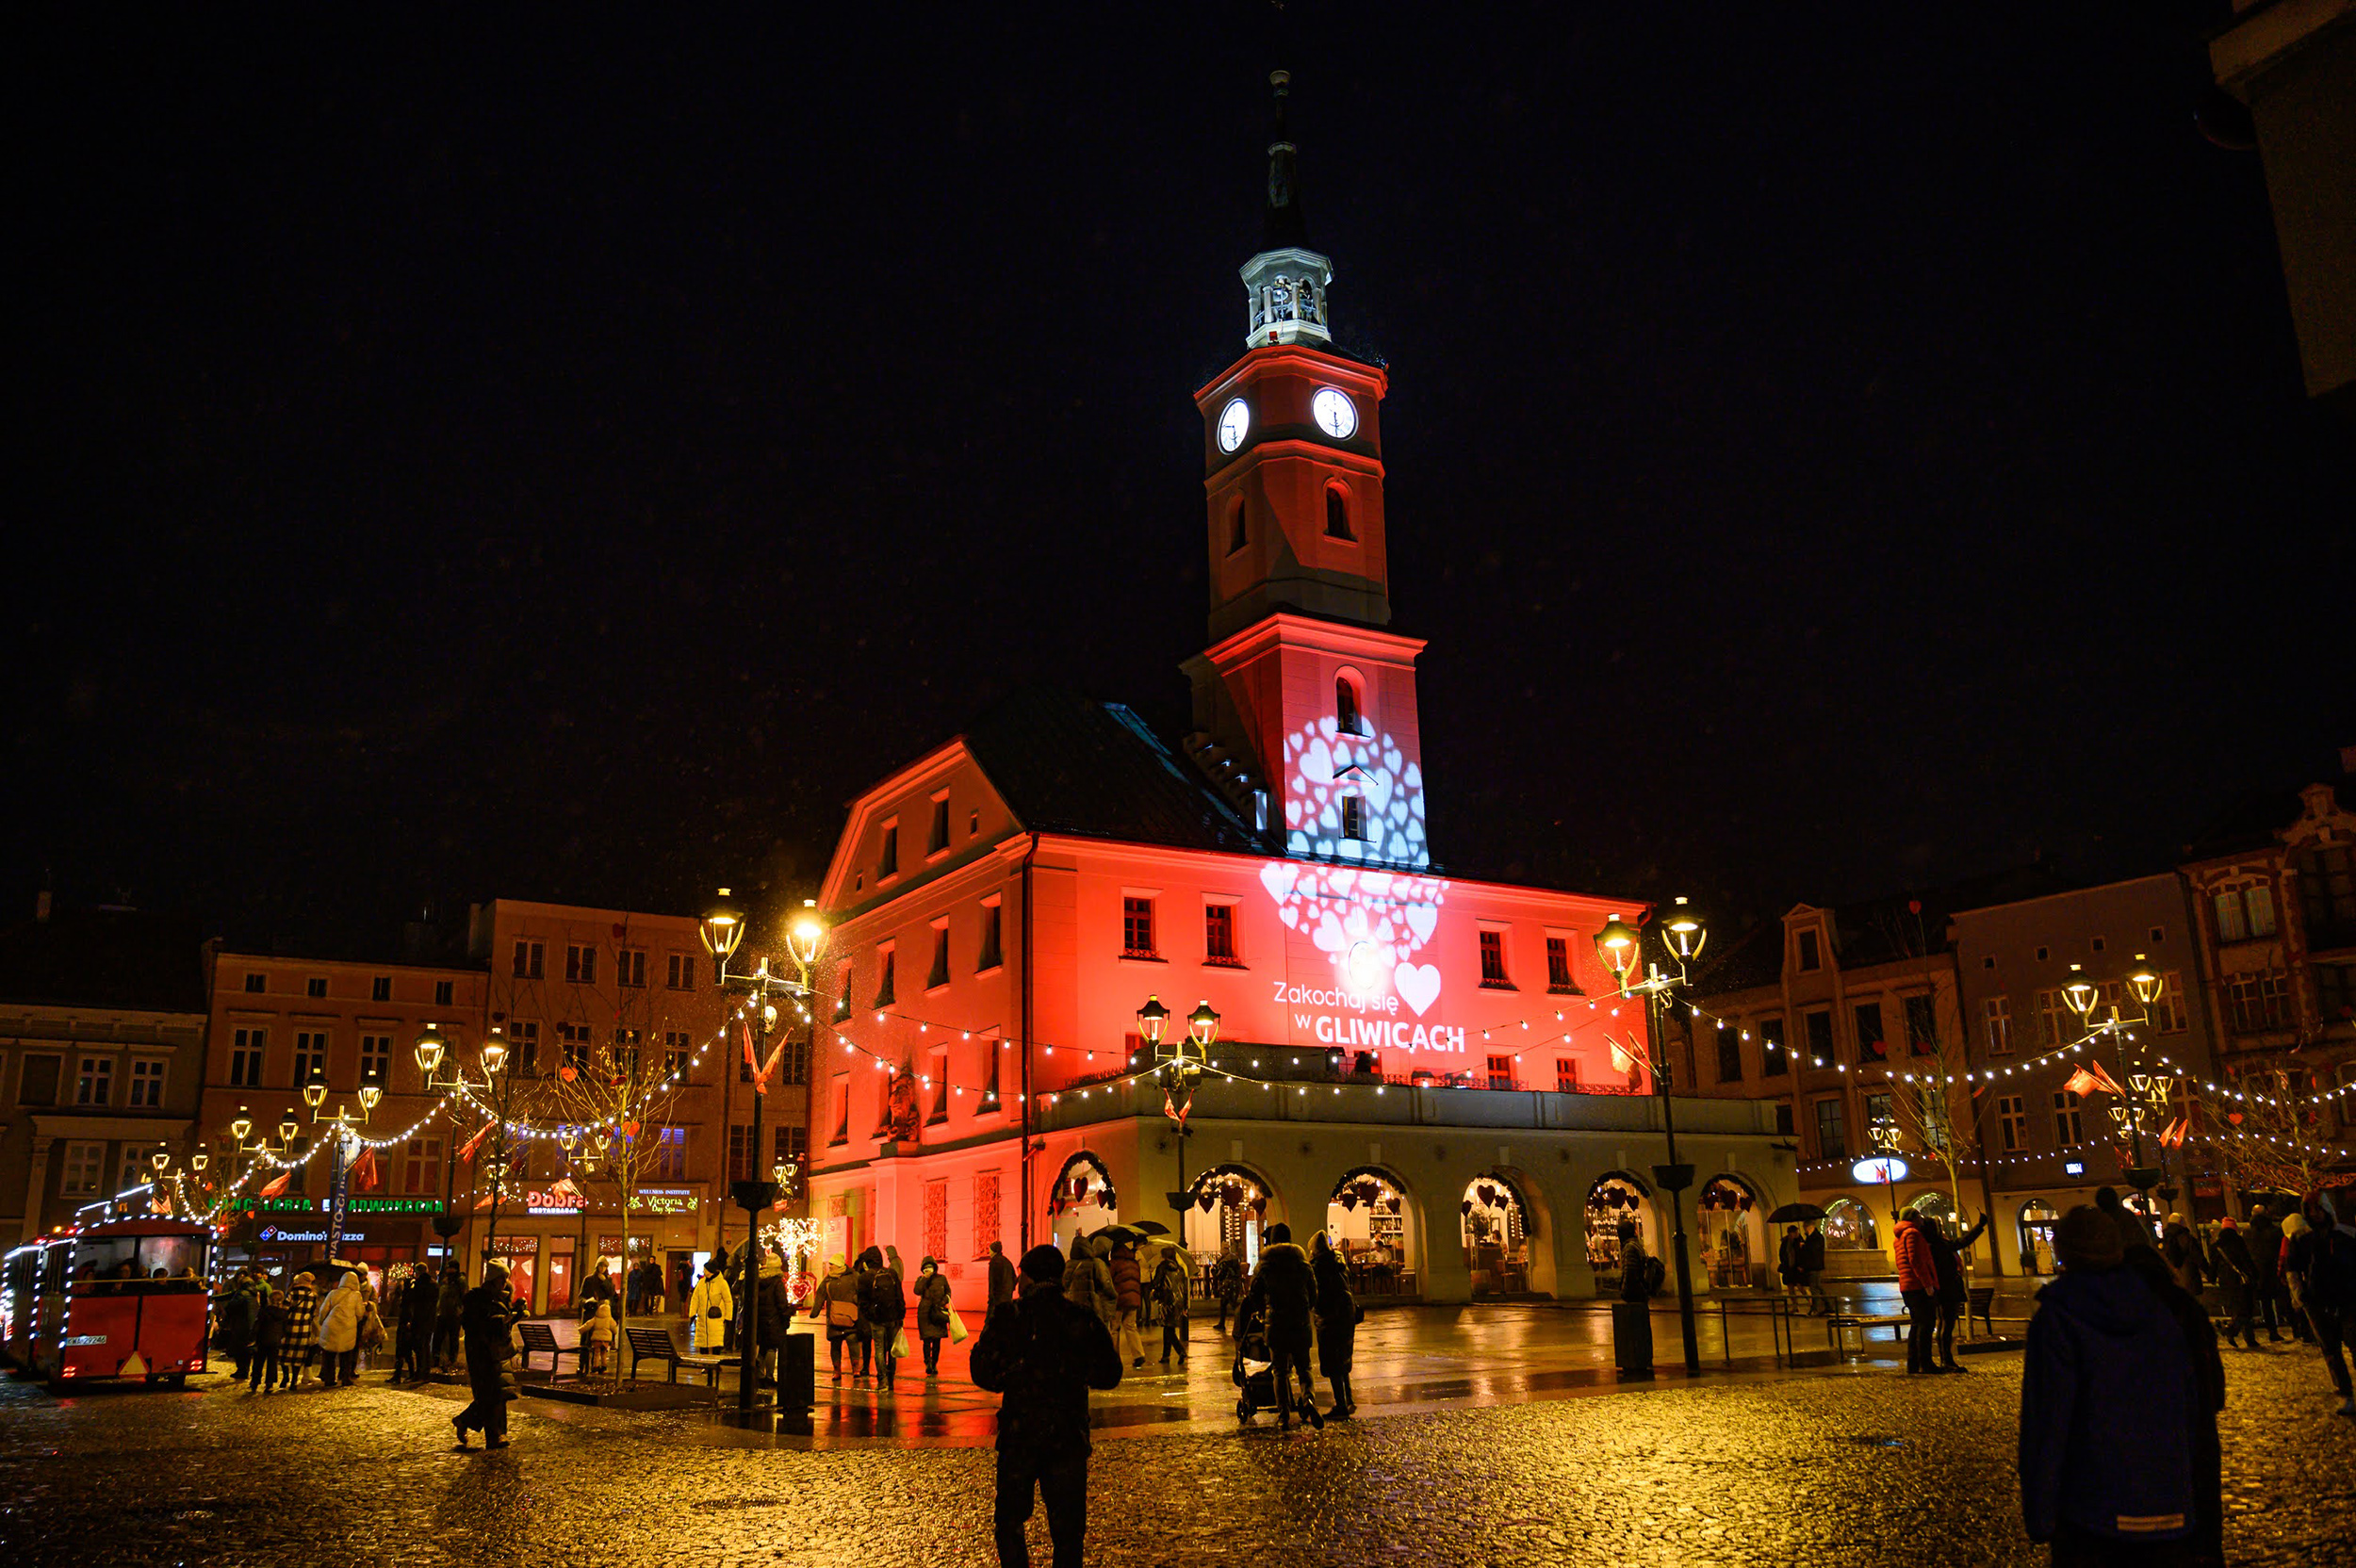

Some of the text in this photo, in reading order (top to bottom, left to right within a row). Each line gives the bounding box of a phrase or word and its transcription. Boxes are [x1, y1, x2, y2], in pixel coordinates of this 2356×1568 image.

[1273, 981, 1399, 1016] Zakochaj się
[1295, 1013, 1464, 1053] w GLIWICACH
[528, 1191, 587, 1208] Dobra
[646, 1196, 682, 1206] Victoria
[348, 1200, 443, 1213] ADWOKACKA
[664, 1206, 676, 1215] Spa
[342, 1232, 365, 1241] izza
